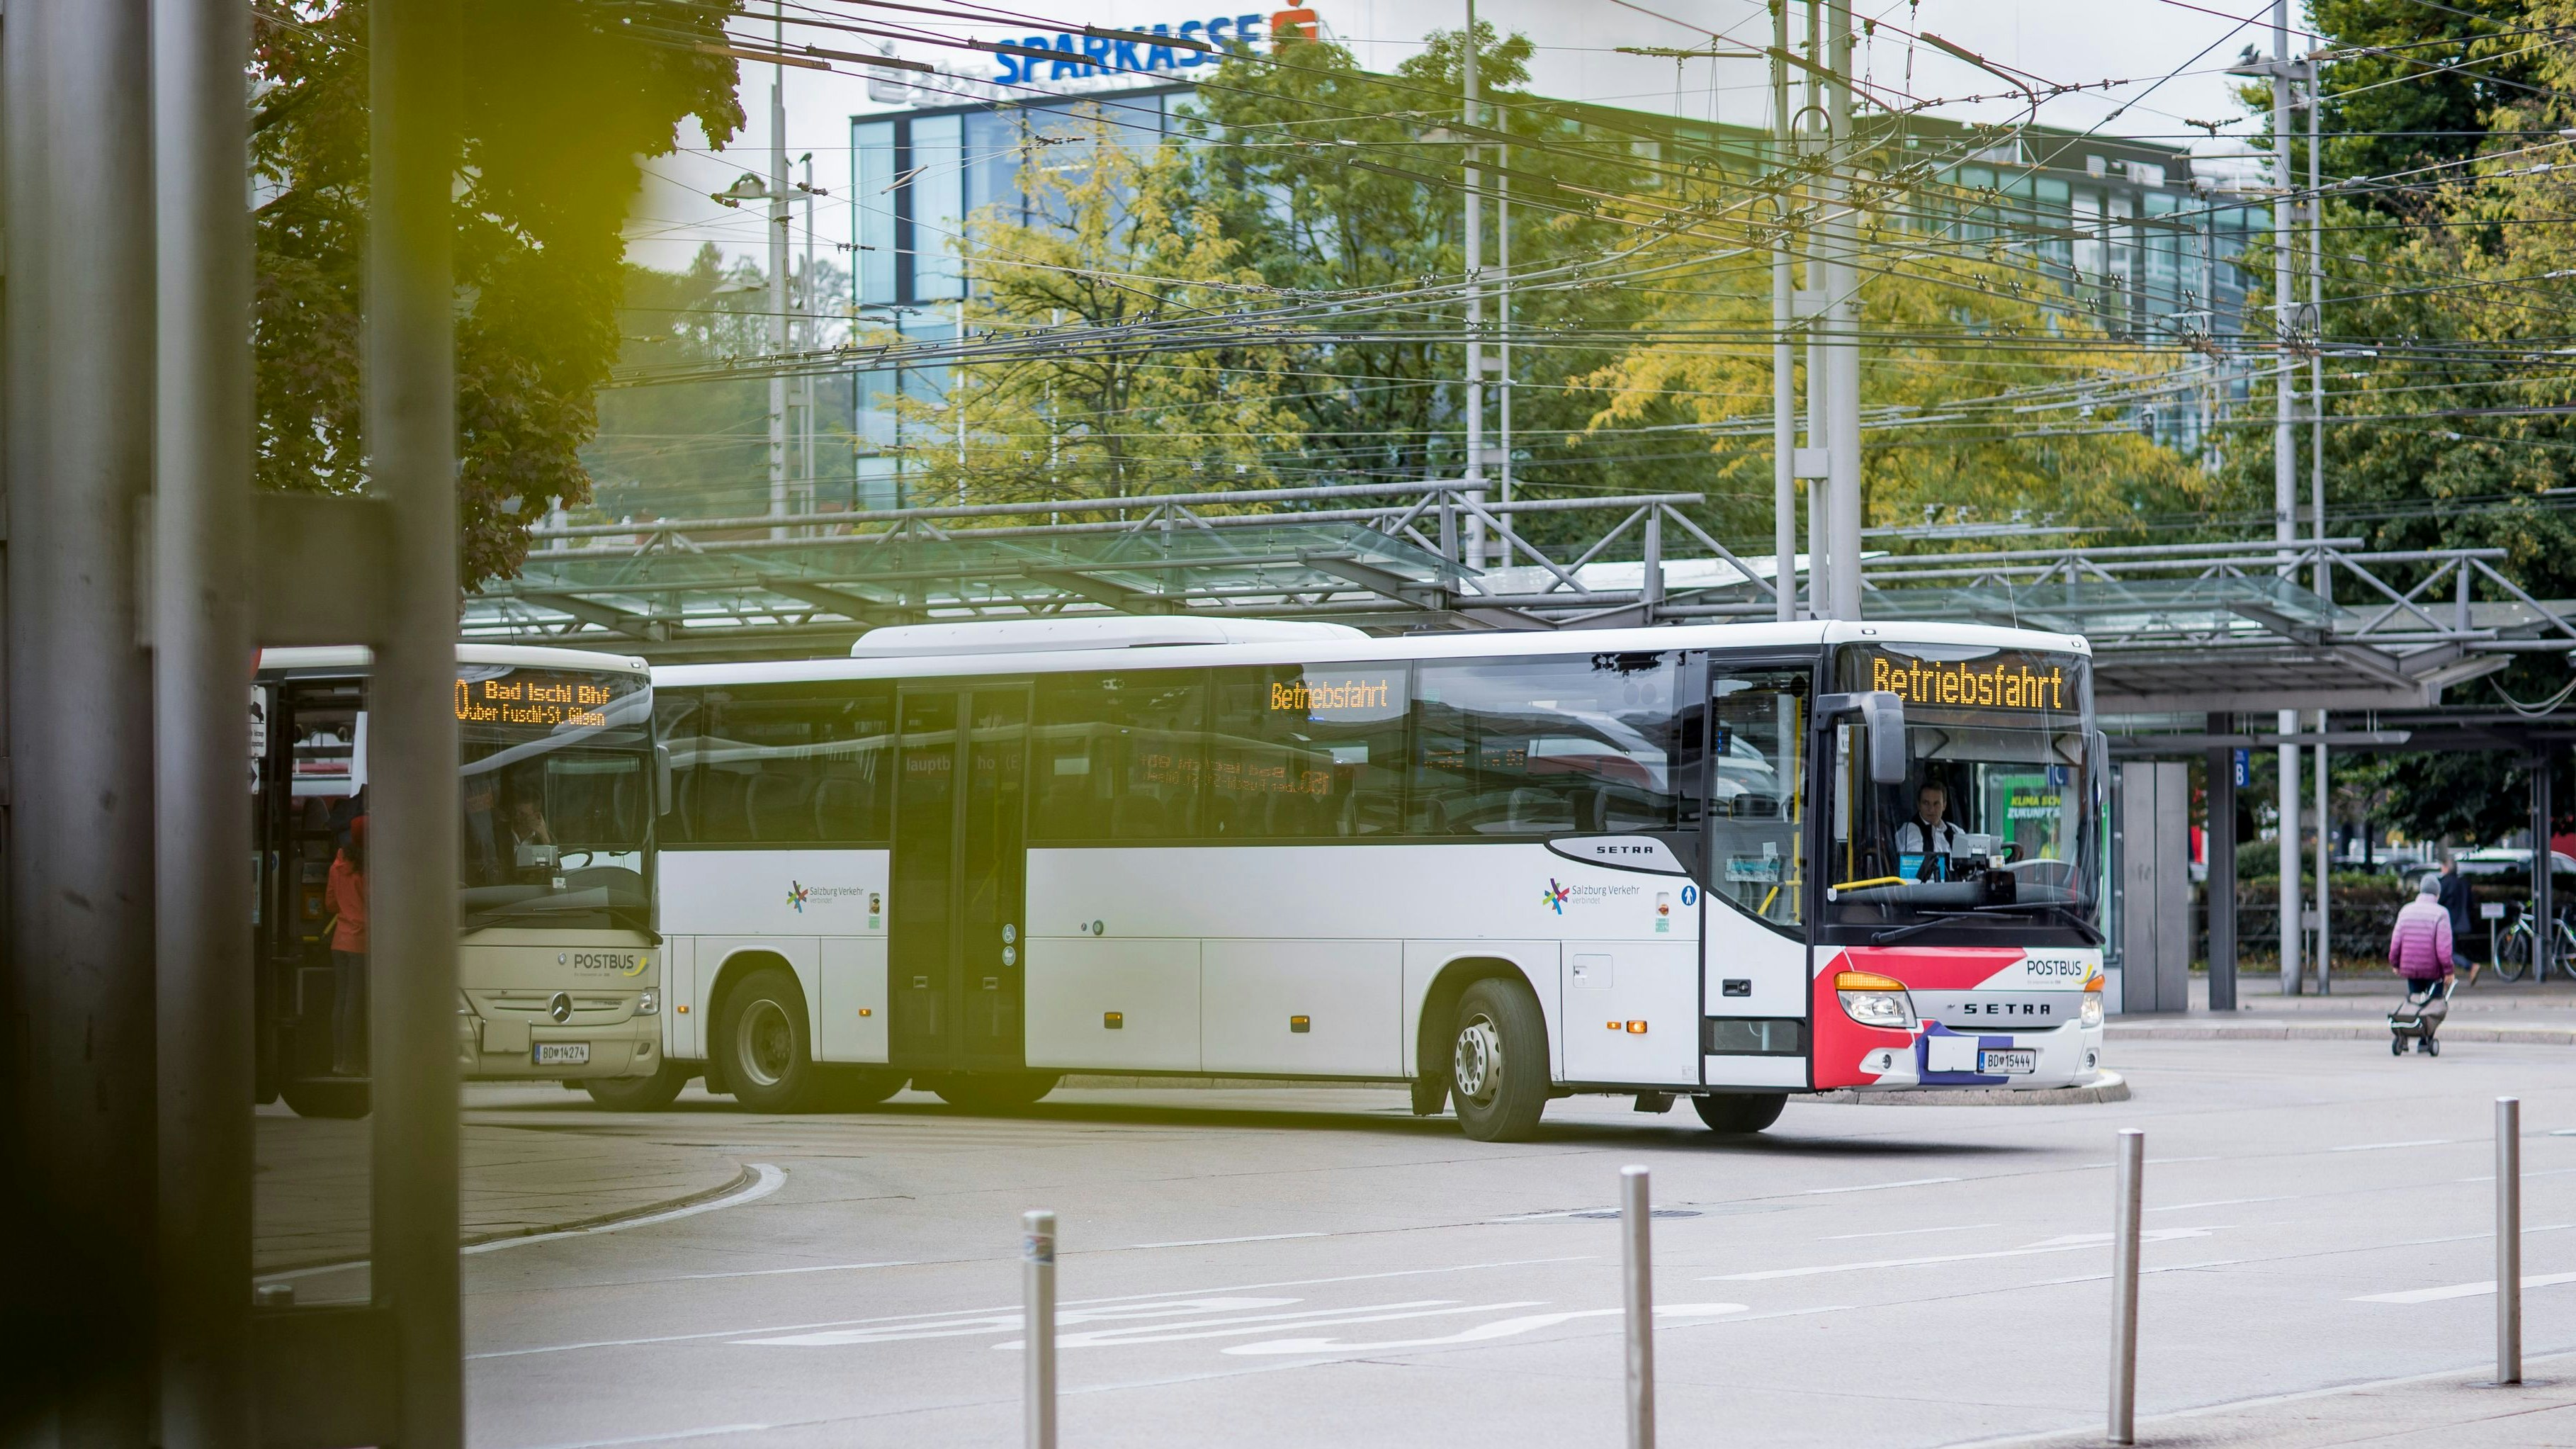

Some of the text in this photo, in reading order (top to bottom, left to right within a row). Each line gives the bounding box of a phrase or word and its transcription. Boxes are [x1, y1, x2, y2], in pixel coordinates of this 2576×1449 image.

[994, 13, 1262, 84] SPARKASSE
[1874, 658, 2062, 709] Betriebsfahrt
[485, 680, 610, 704] Bad Ischl Bhf
[1270, 680, 1388, 710] Betriebsfahrt
[568, 707, 605, 726] Gilgen
[2236, 763, 2244, 786] B
[2011, 795, 2039, 806] KLIMA
[2007, 806, 2054, 819] ZUKUNFT
[810, 886, 864, 897] Salzburg Verkehr
[1571, 885, 1640, 896] Salzburg Verkehr
[574, 953, 634, 969] POSTBUS
[2027, 960, 2081, 976] POSTBUS
[1964, 1003, 2050, 1015] SETRA
[560, 1046, 584, 1059] 14274
[2005, 1054, 2030, 1066] 15444
